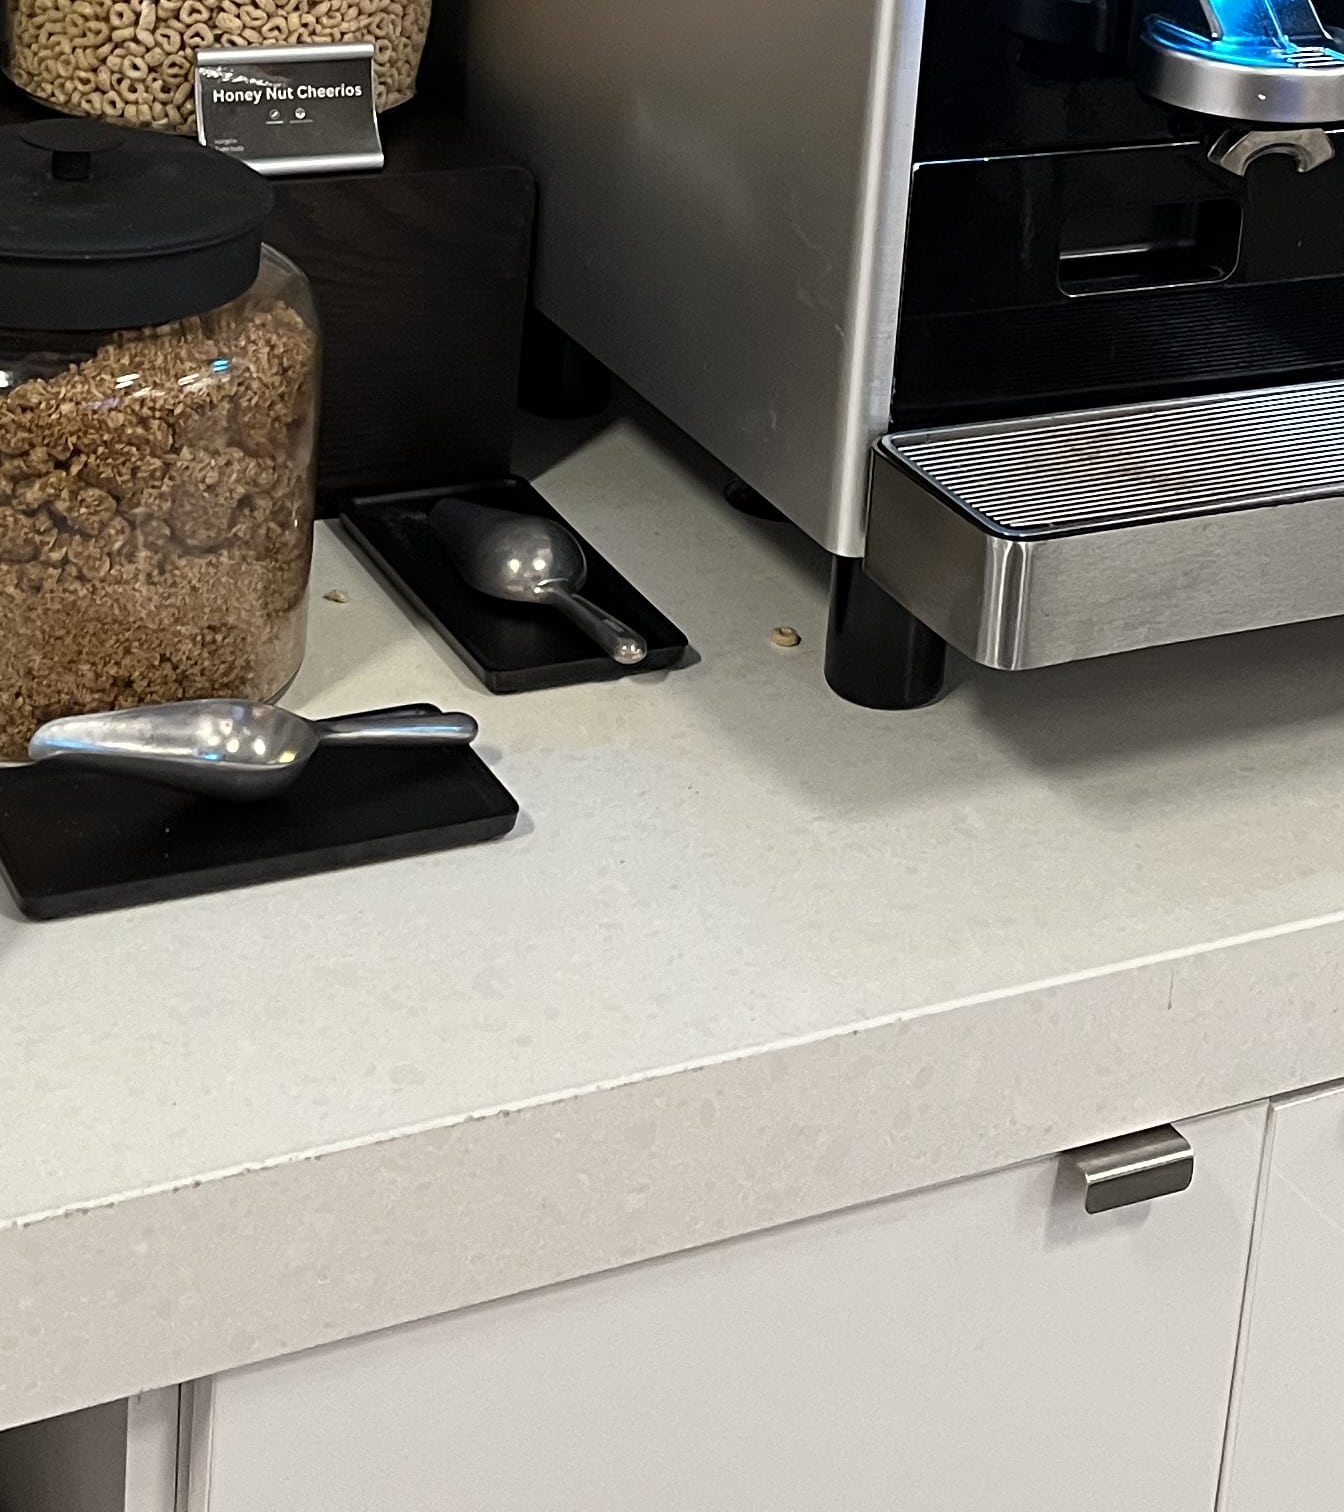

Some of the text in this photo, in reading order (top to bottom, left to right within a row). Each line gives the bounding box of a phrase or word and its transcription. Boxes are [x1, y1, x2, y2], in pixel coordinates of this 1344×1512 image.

[212, 82, 363, 105] Honey Nut Cheerios
